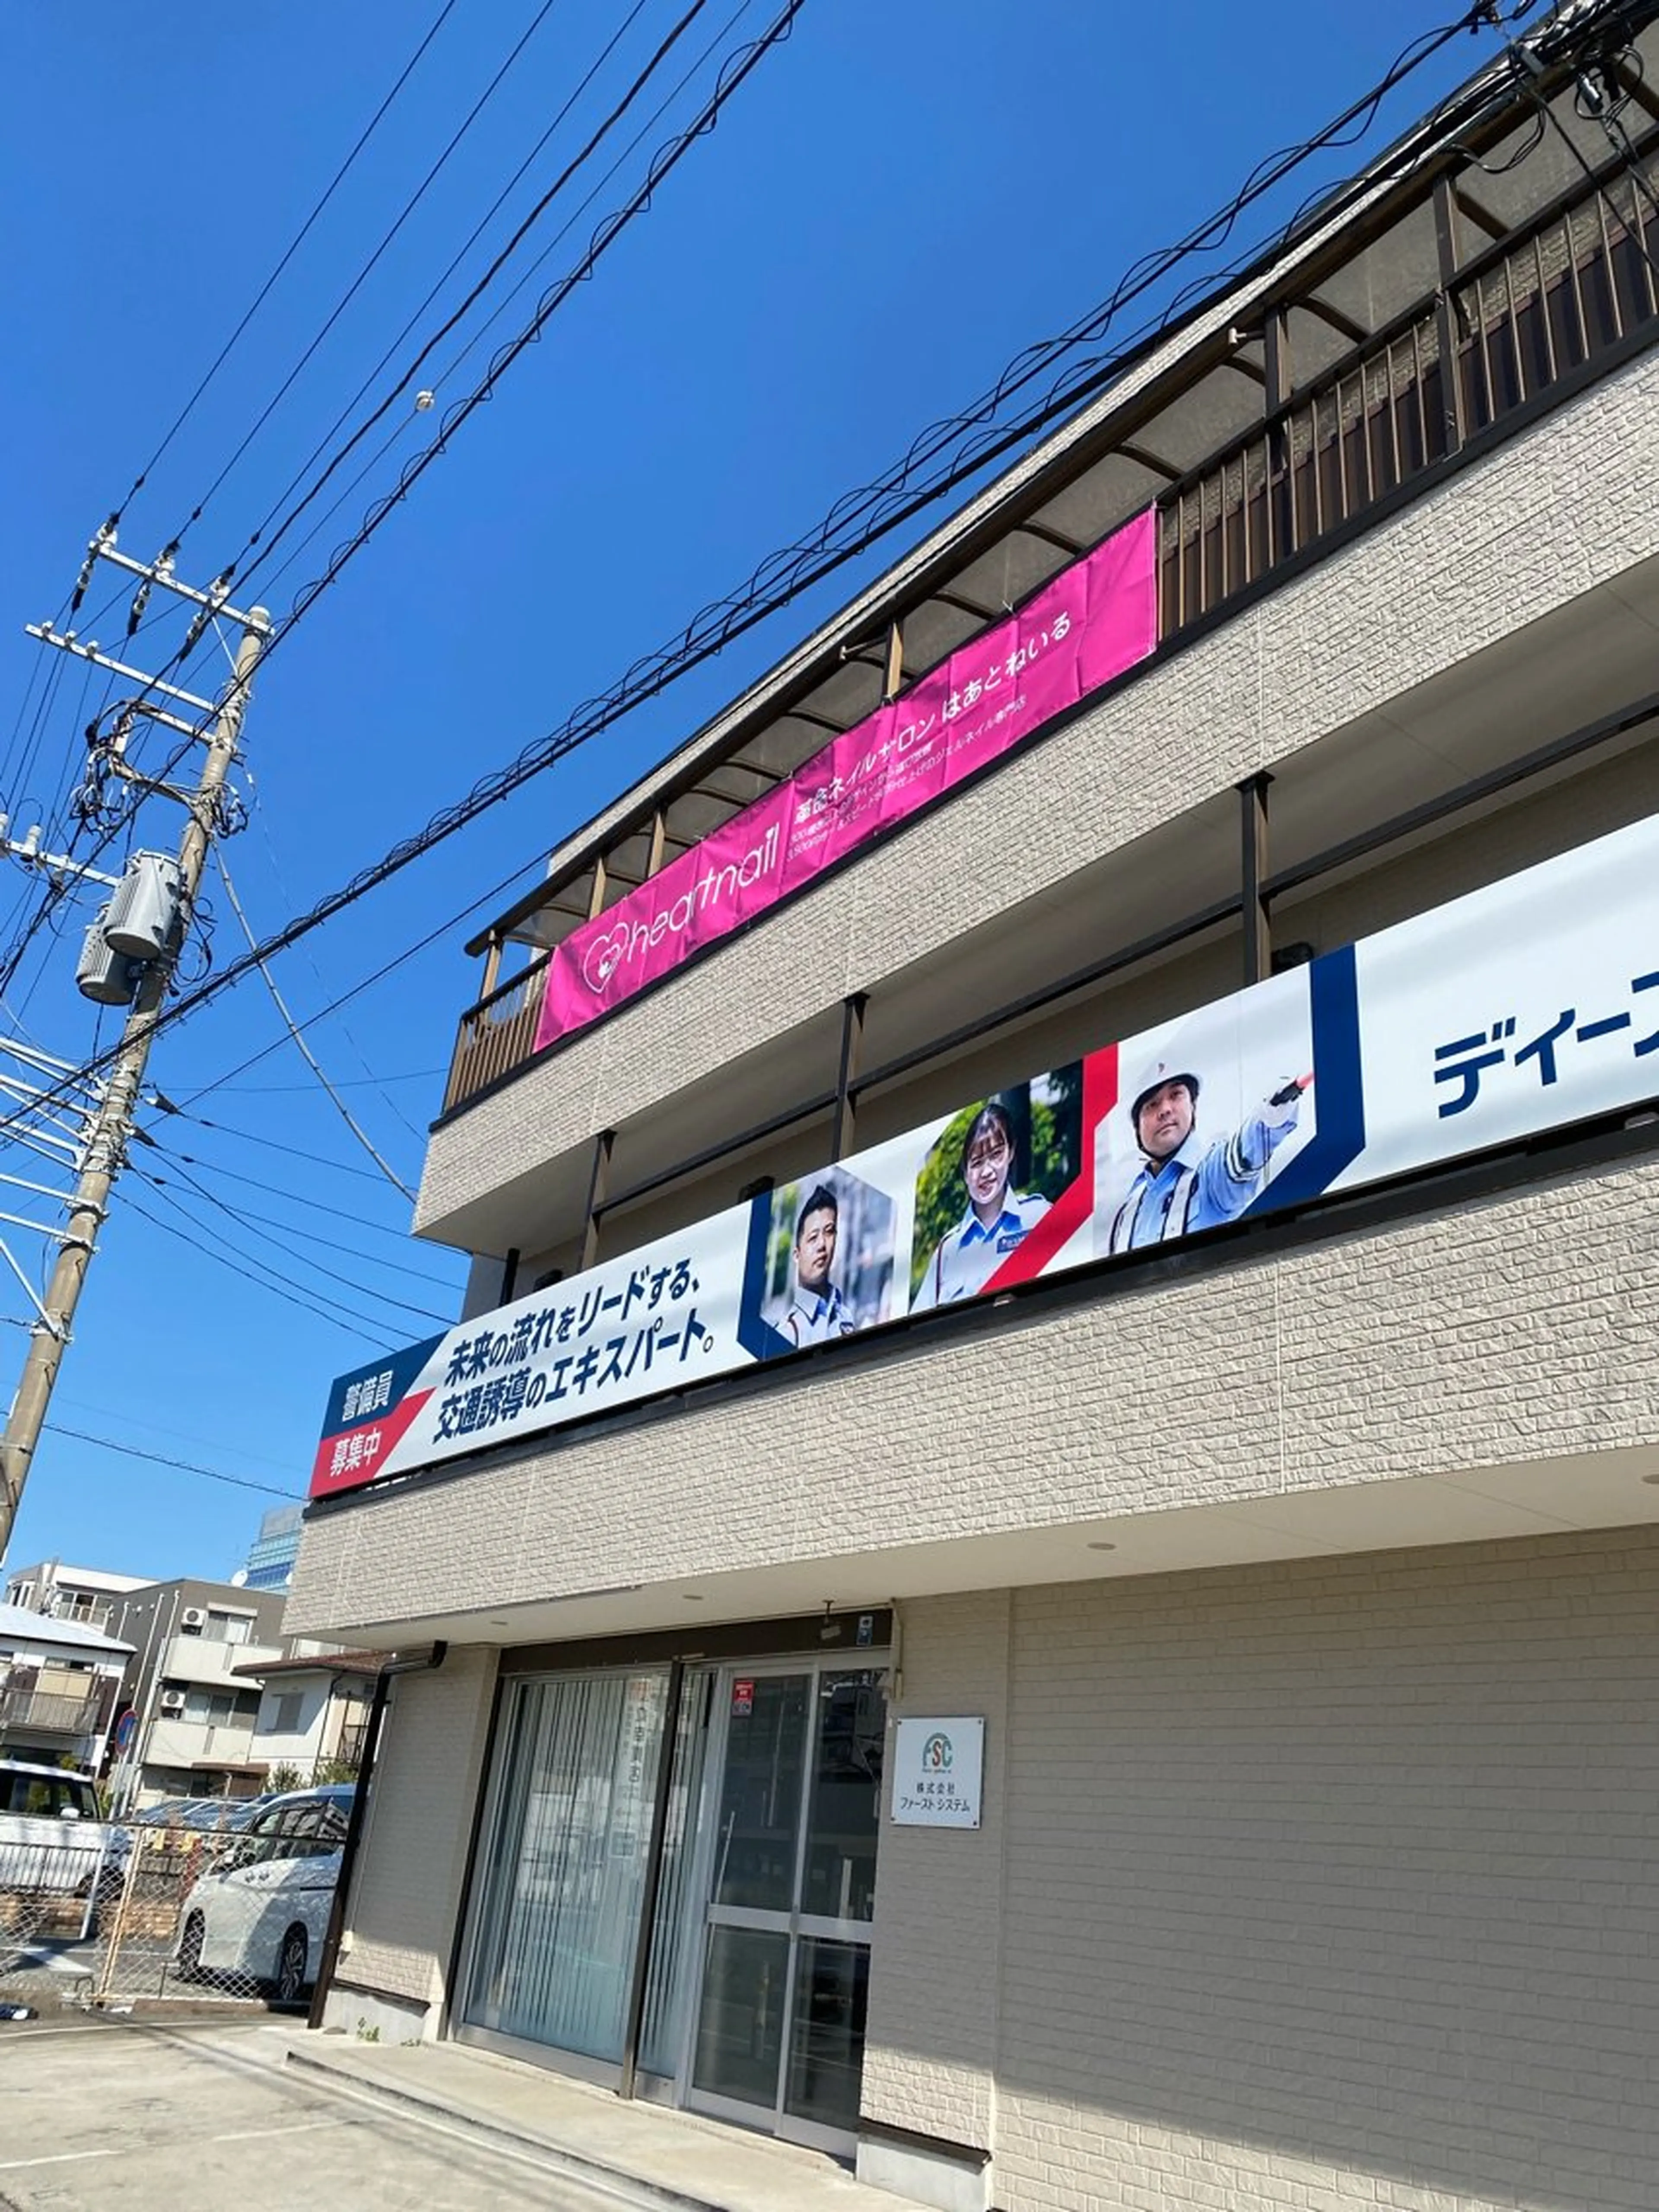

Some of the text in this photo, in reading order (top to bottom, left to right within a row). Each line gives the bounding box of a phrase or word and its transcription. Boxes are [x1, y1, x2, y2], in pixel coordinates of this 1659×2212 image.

[942, 611, 1070, 723] はあとねいる
[628, 822, 779, 963] heartnail
[444, 1258, 699, 1387] 未来の流れをリードする、
[342, 1370, 393, 1422] 警備員
[433, 1307, 713, 1444] 交通誘導のエキスパート。
[330, 1427, 381, 1477] 募集中
[901, 1797, 970, 1812] ファースト システム
[917, 1782, 954, 1794] 株式会社
